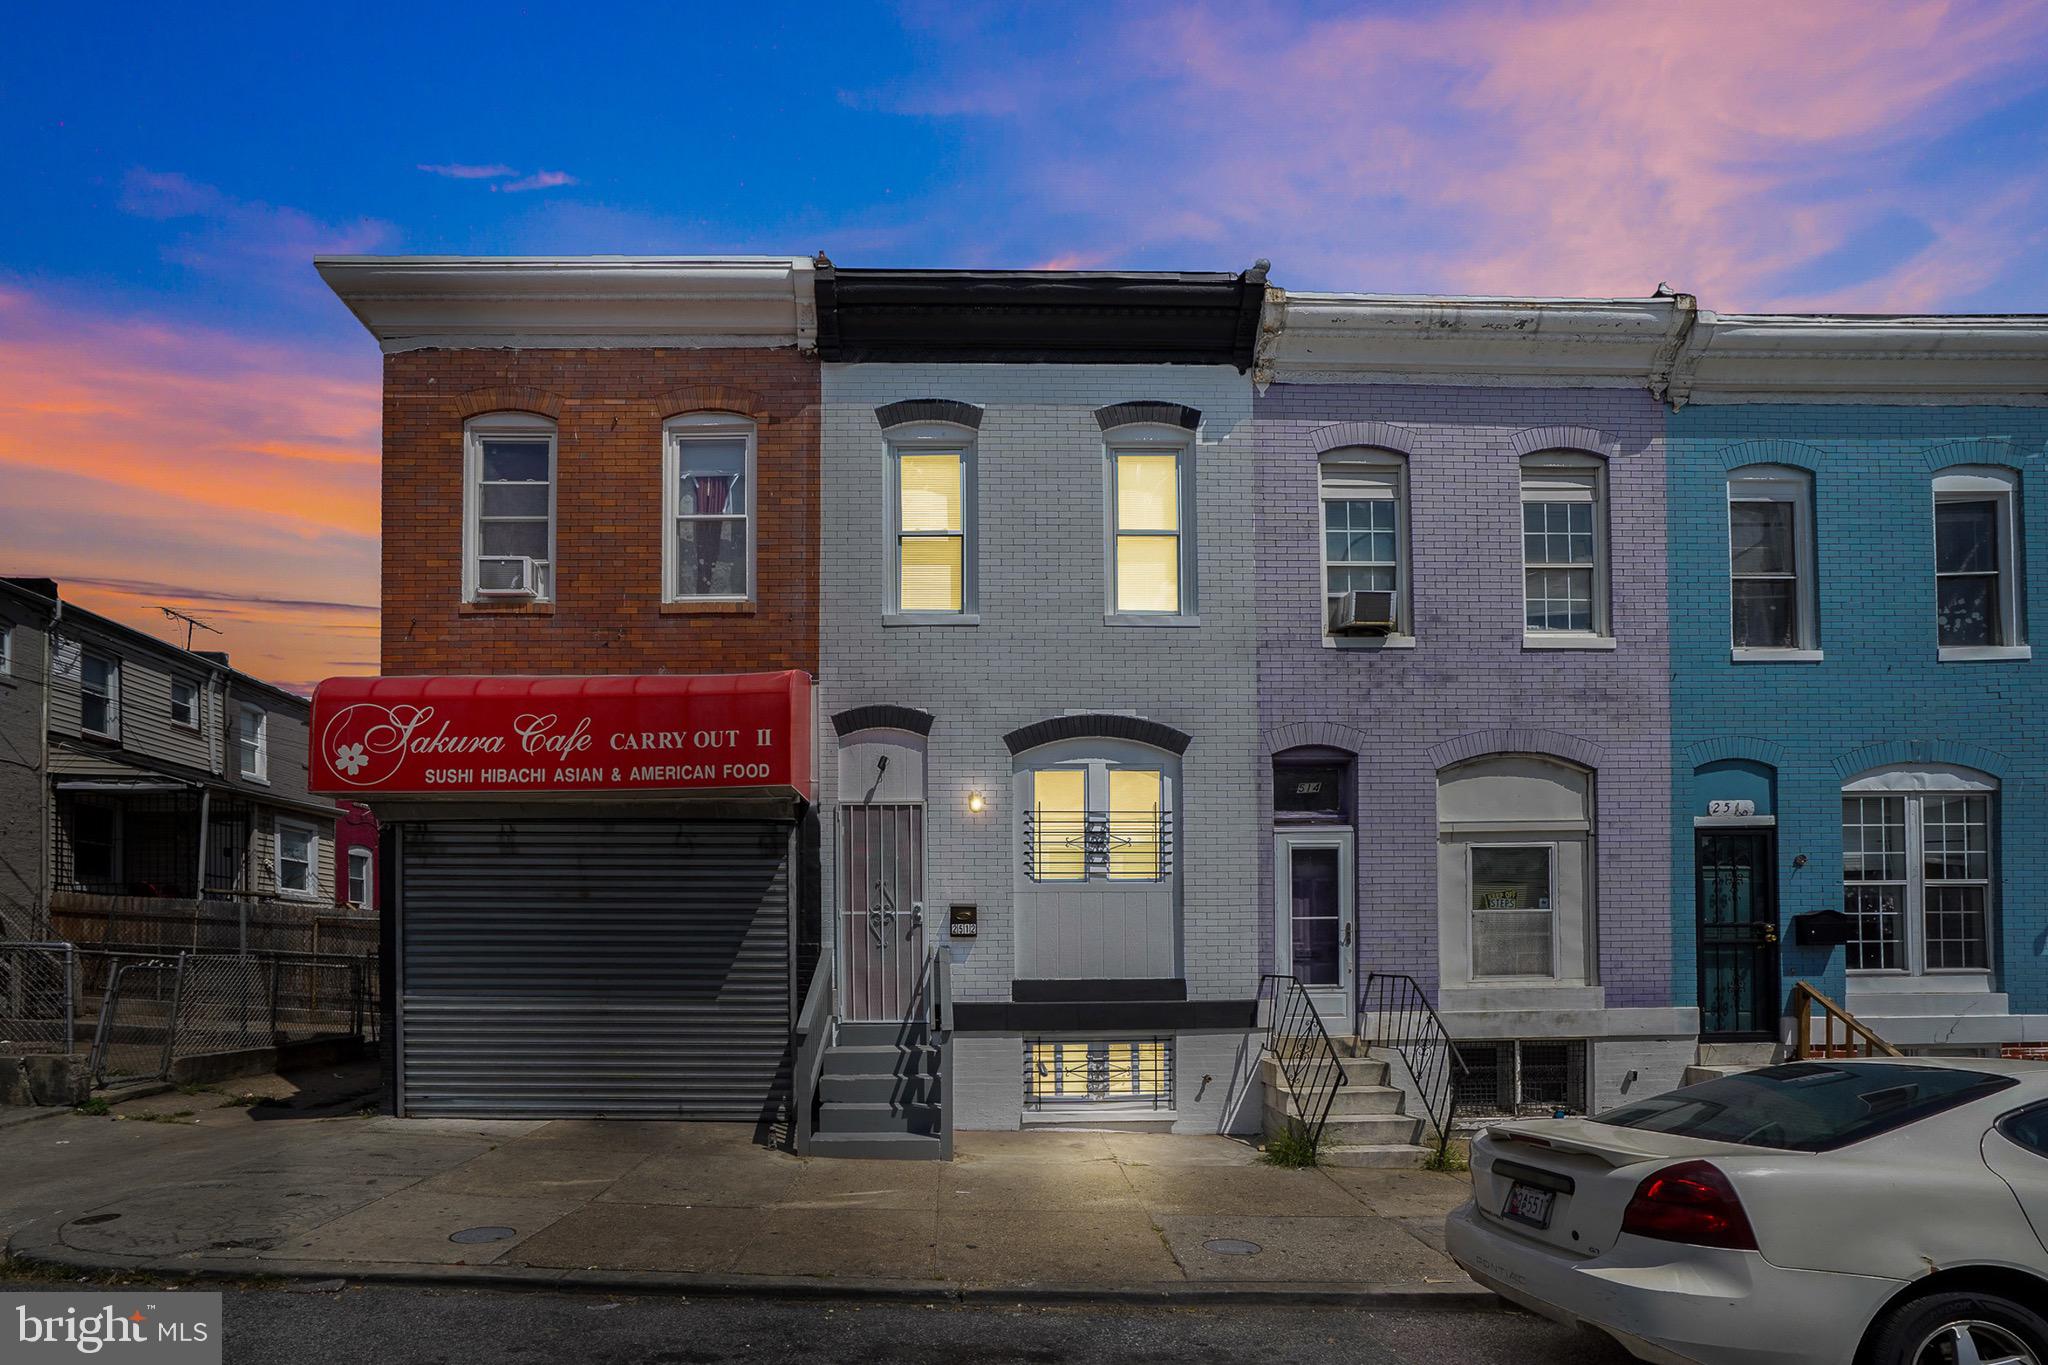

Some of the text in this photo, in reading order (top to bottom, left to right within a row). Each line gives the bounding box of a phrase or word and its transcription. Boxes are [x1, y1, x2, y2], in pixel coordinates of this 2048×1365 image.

[364, 704, 773, 761] Sakura Cafe CARRY OUT II
[424, 763, 770, 784] SUSHI HIBACHI ASIAN & AMERICAN FOOD
[1490, 899, 1515, 908] STEPS
[952, 924, 976, 934] 2512
